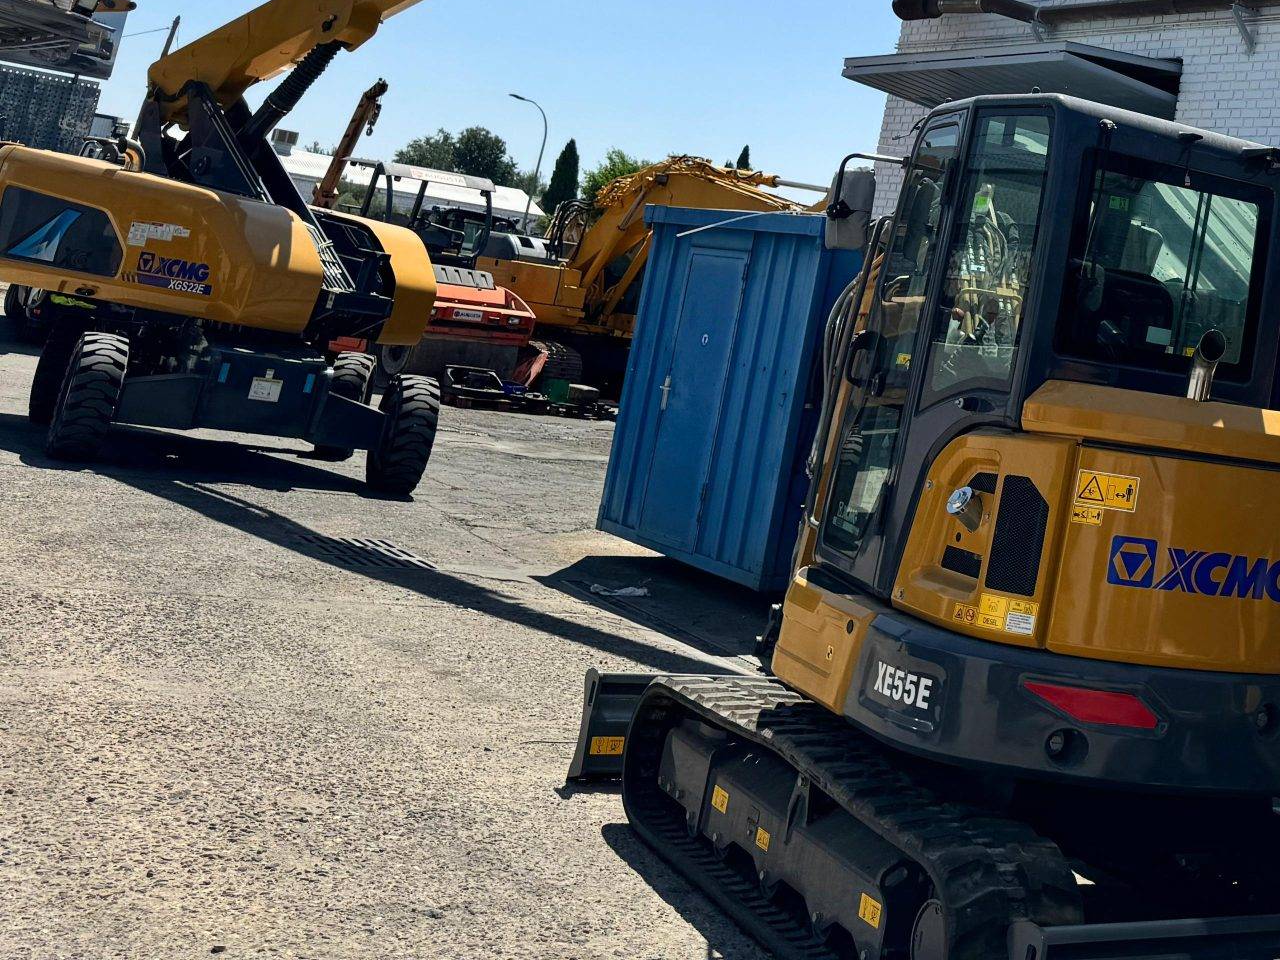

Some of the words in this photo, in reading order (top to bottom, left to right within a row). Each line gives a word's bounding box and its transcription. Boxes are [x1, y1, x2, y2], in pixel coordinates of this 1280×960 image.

[151, 256, 210, 282] XCMG
[168, 279, 206, 294] XGS22E
[983, 616, 999, 627] DIESEL
[873, 660, 934, 710] XE55E
